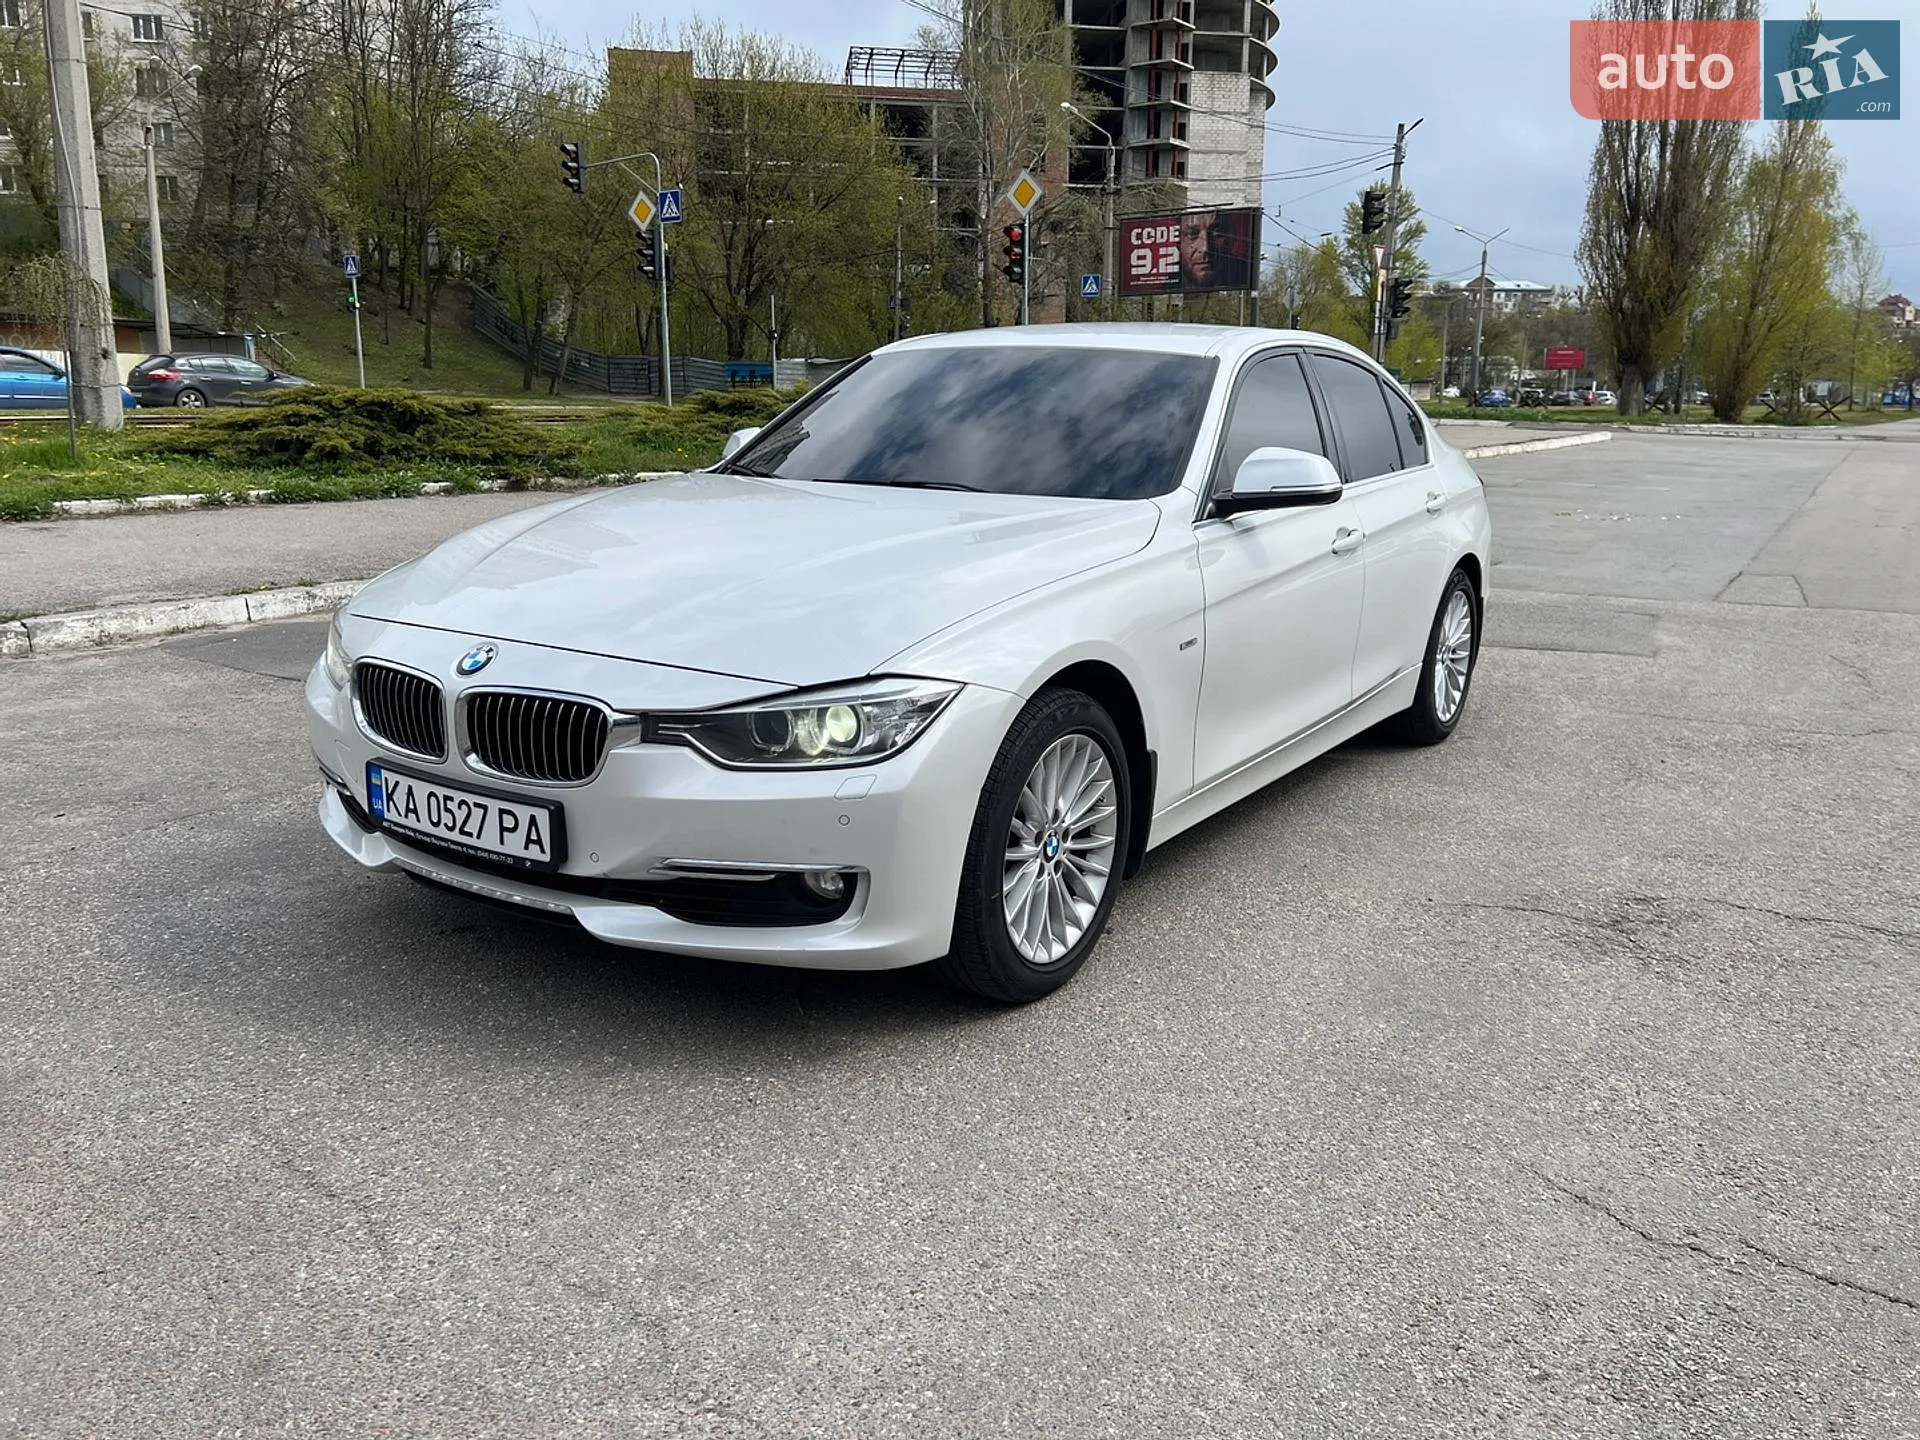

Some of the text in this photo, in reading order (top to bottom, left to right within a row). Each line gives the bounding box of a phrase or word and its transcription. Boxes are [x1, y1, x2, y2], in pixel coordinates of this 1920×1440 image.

[1130, 225, 1180, 246] CODE
[372, 798, 383, 810] UA
[384, 777, 421, 823] KA
[426, 791, 488, 840] 0527
[498, 807, 546, 854] PA
